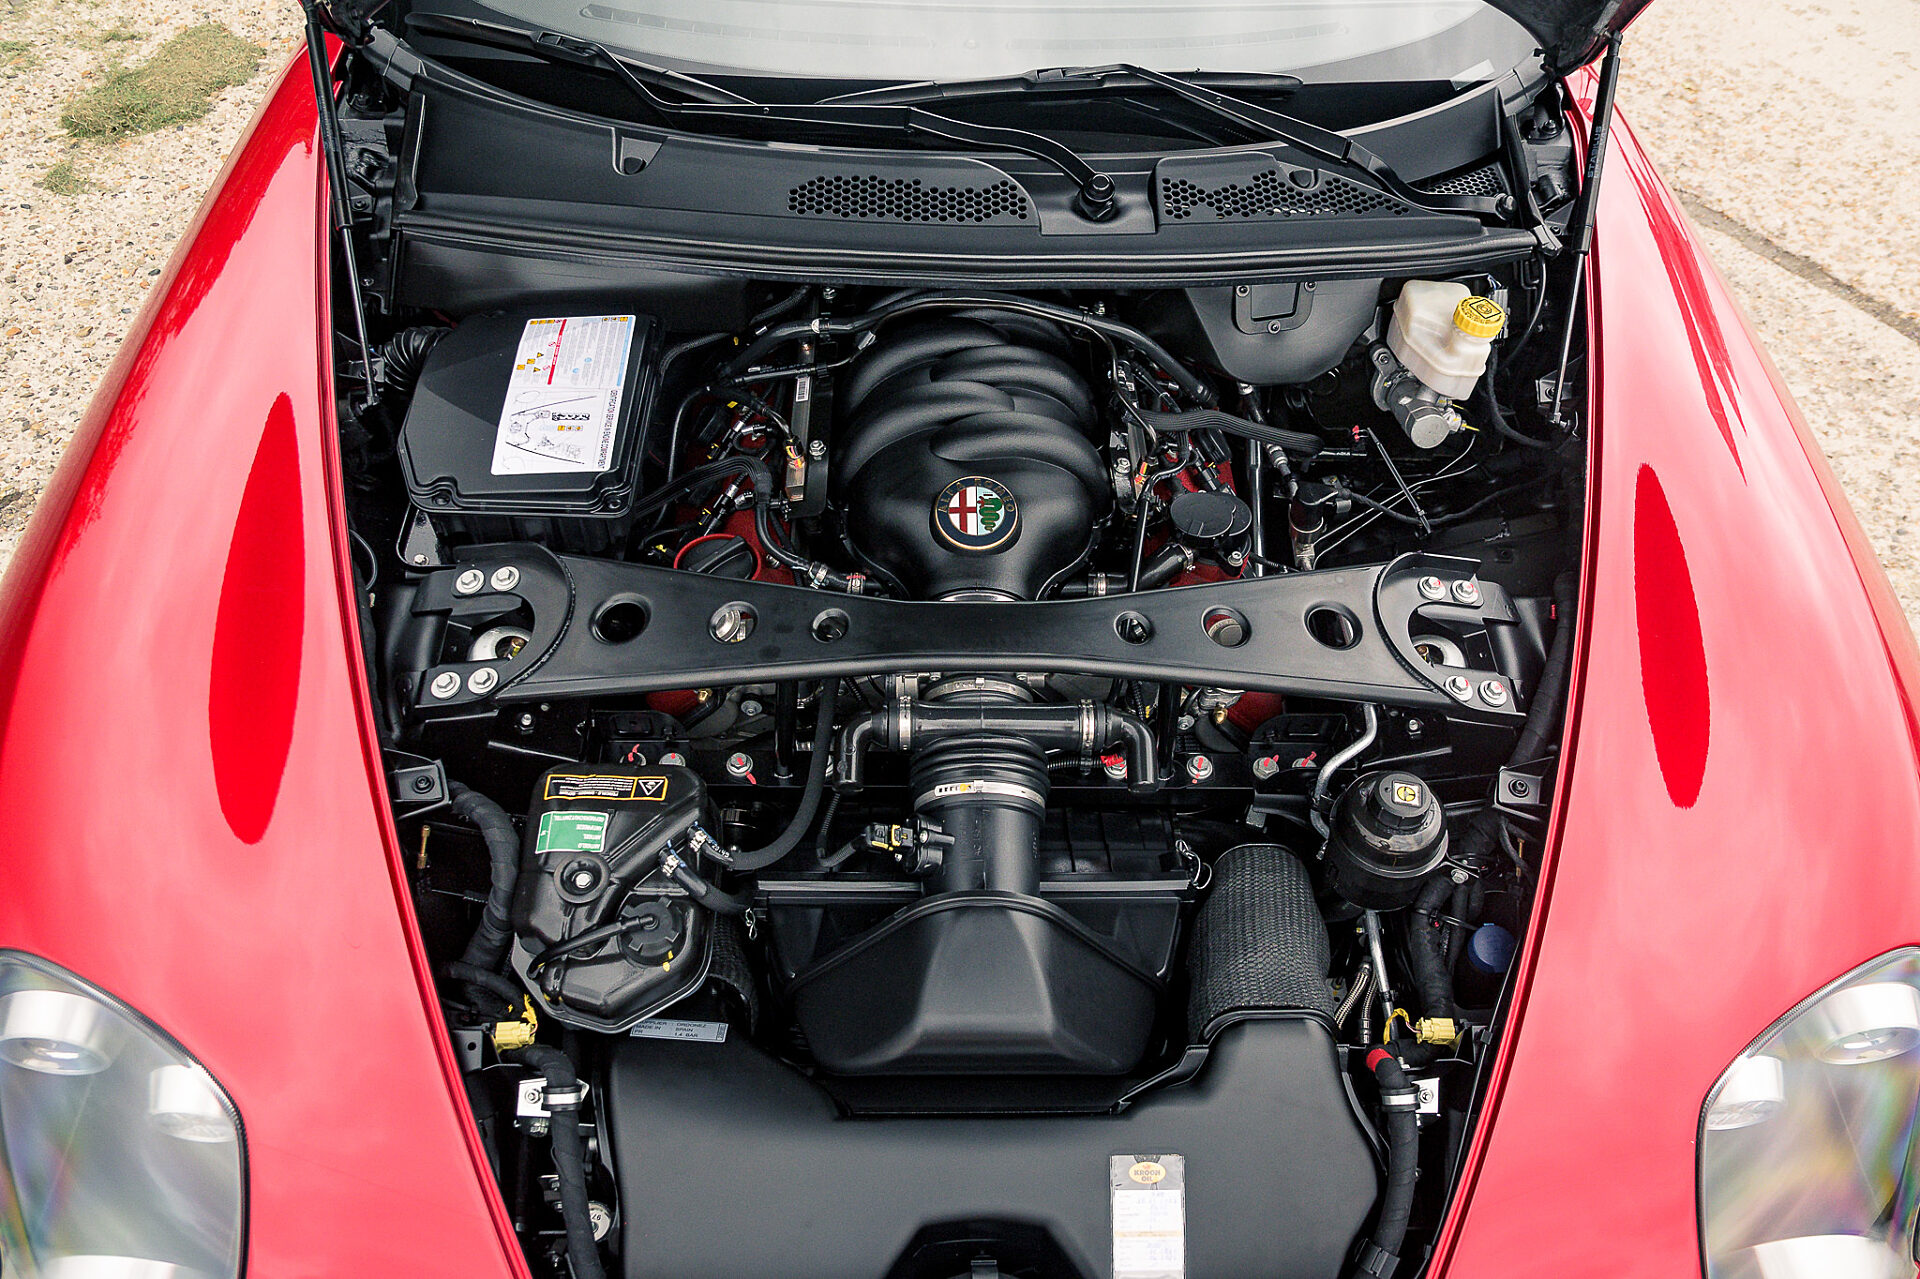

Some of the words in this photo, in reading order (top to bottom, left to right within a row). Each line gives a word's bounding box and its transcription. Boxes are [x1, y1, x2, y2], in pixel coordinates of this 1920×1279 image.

[1588, 126, 1602, 178] STABILUS
[938, 481, 963, 512] ALFA
[975, 478, 1014, 511] ROMEO
